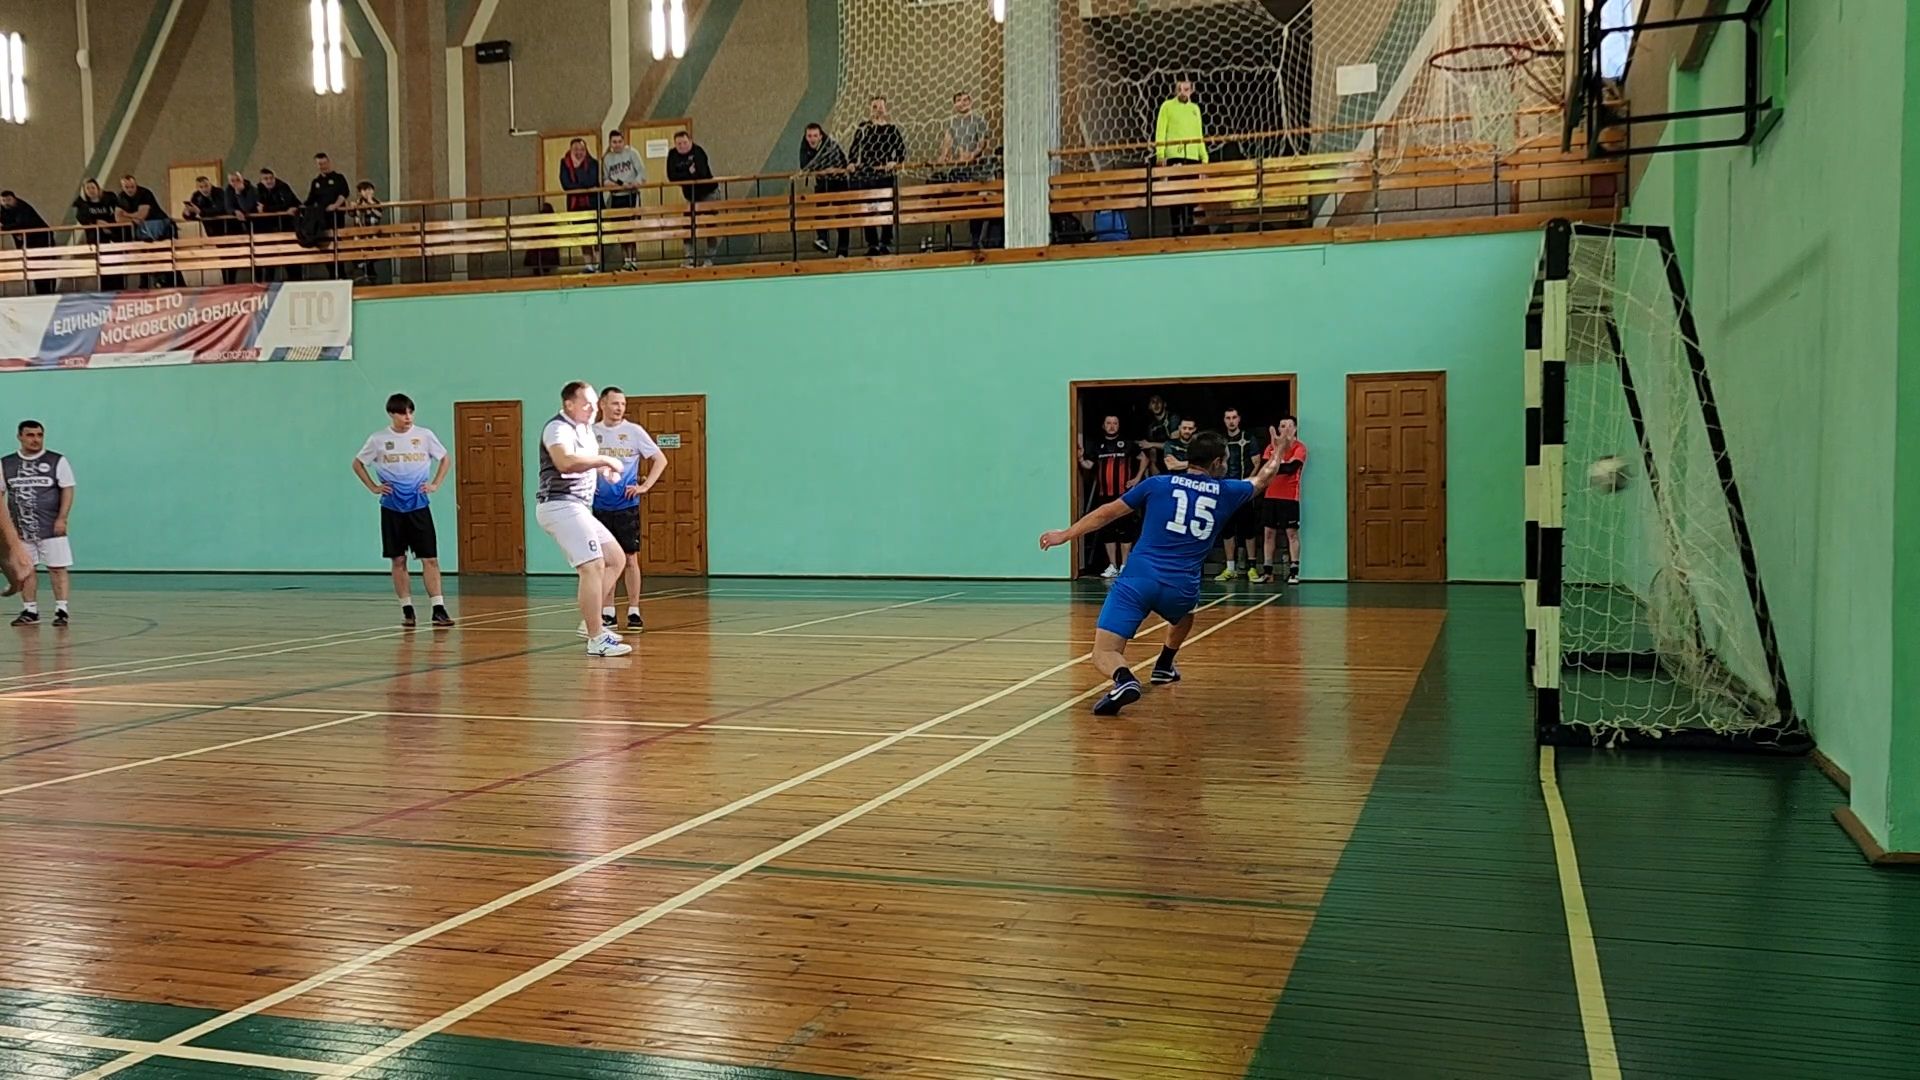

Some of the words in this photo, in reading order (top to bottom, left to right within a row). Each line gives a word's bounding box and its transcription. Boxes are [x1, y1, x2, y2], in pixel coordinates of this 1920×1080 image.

[53, 304, 113, 336] ЕДИНЫЙ
[115, 299, 153, 323] ДЕНЬ
[156, 292, 183, 312] ГТО
[100, 307, 200, 346] МОСКОВСКОЙ
[201, 293, 269, 323] ОБЛАСТИ
[289, 291, 335, 326] ГТО
[1170, 475, 1220, 495] DERGACH
[1166, 488, 1217, 540] 15
[588, 539, 598, 552] 8
